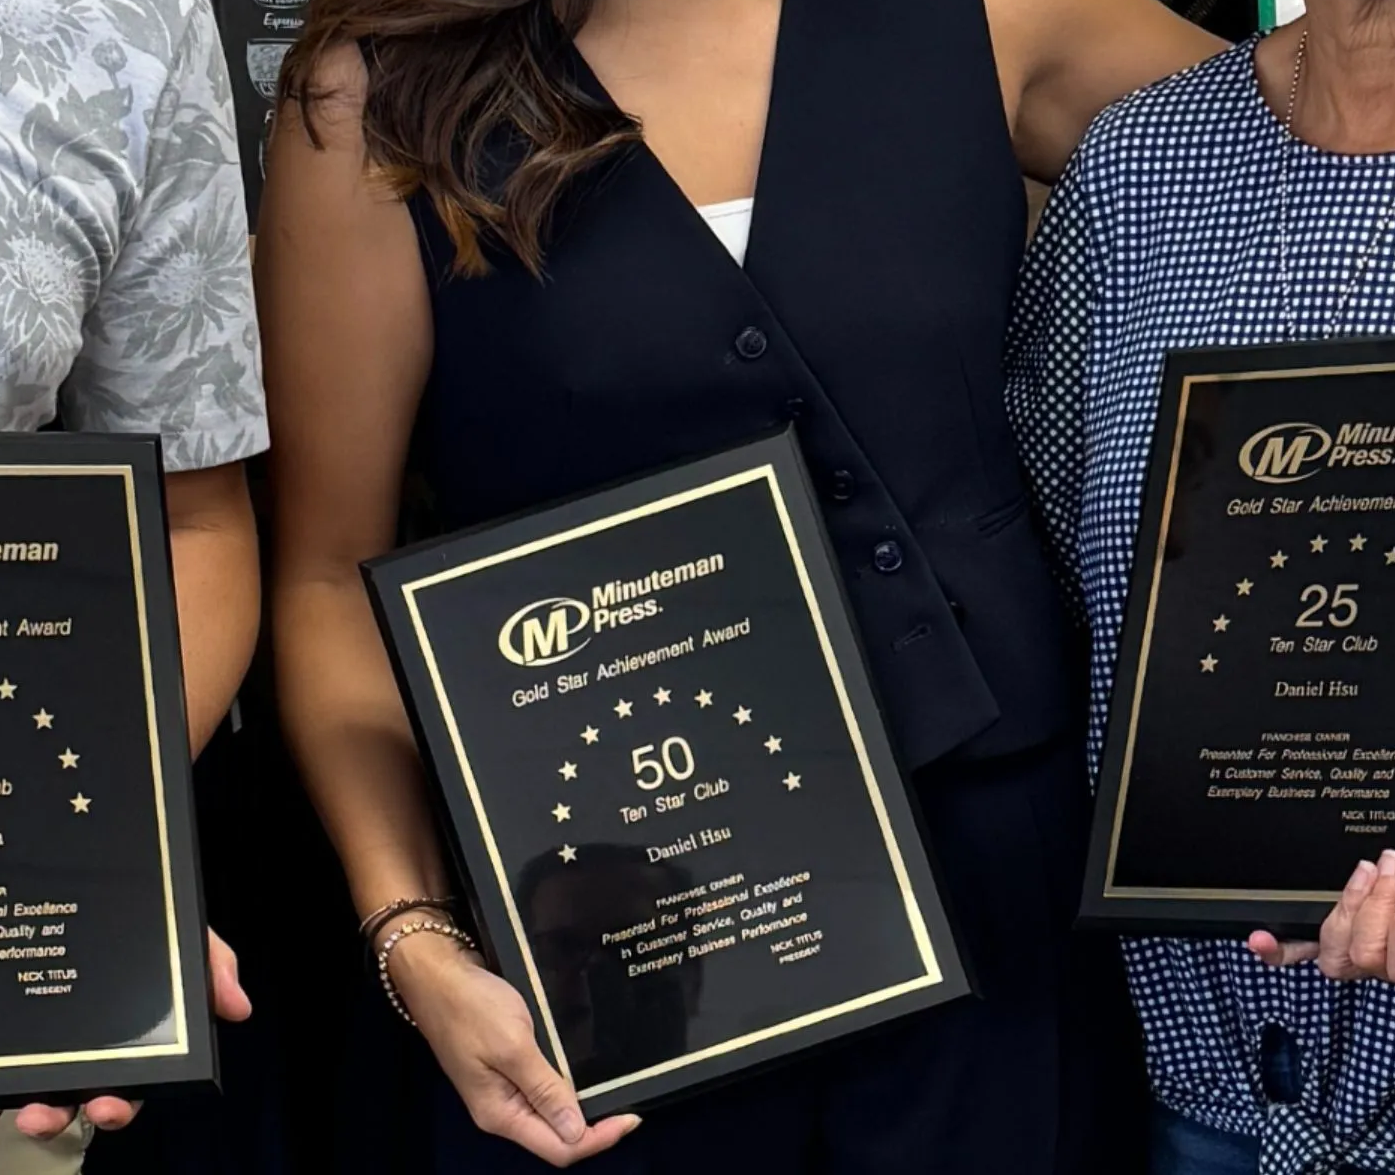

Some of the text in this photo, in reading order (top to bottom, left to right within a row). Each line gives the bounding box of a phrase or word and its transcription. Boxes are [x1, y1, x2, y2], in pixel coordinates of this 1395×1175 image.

[1226, 498, 1265, 515] Gold
[1269, 497, 1304, 514] Star
[592, 553, 725, 609] Minuteman
[593, 598, 664, 634] Press.
[1295, 583, 1359, 627] 25
[16, 618, 73, 637] Award
[1269, 635, 1378, 653] Ten Star Club
[511, 617, 751, 708] Gold Star Achievement Award
[1274, 680, 1359, 697] Daniel Hsu
[631, 736, 695, 790] 50
[1372, 768, 1395, 780] and
[619, 778, 730, 824] Ten Star Club
[646, 827, 733, 863] Daniel Hsu
[13, 902, 78, 917] Excellence
[661, 912, 679, 927] For
[684, 889, 749, 919] Professional
[753, 871, 811, 897] Excellence
[41, 923, 65, 937] and
[636, 929, 688, 955] Customer
[740, 900, 778, 922] Quality
[782, 891, 803, 908] and
[628, 912, 808, 977] Exemplary Business Performance
